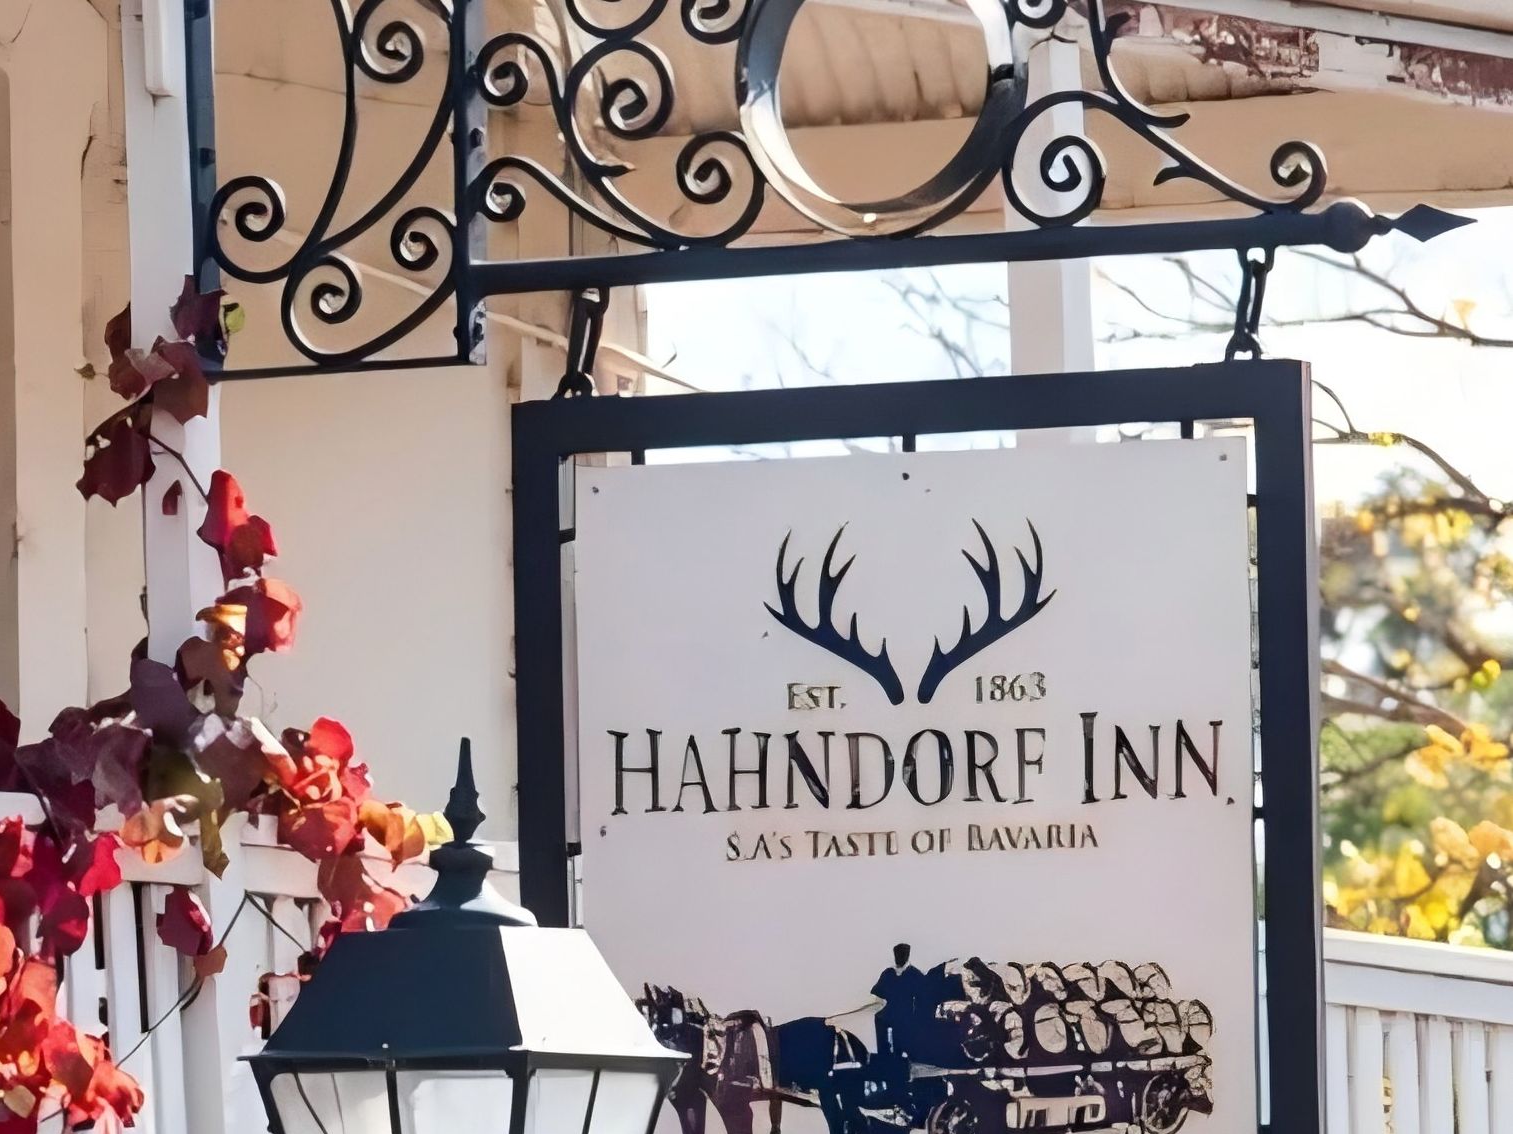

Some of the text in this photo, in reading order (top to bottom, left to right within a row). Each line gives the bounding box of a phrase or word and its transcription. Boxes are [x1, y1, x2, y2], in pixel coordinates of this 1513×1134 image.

[606, 726, 1047, 817] HAHNDORF
[804, 829, 900, 861] TASTE
[910, 826, 952, 856] OF
[966, 822, 1100, 853] BAVARIA
